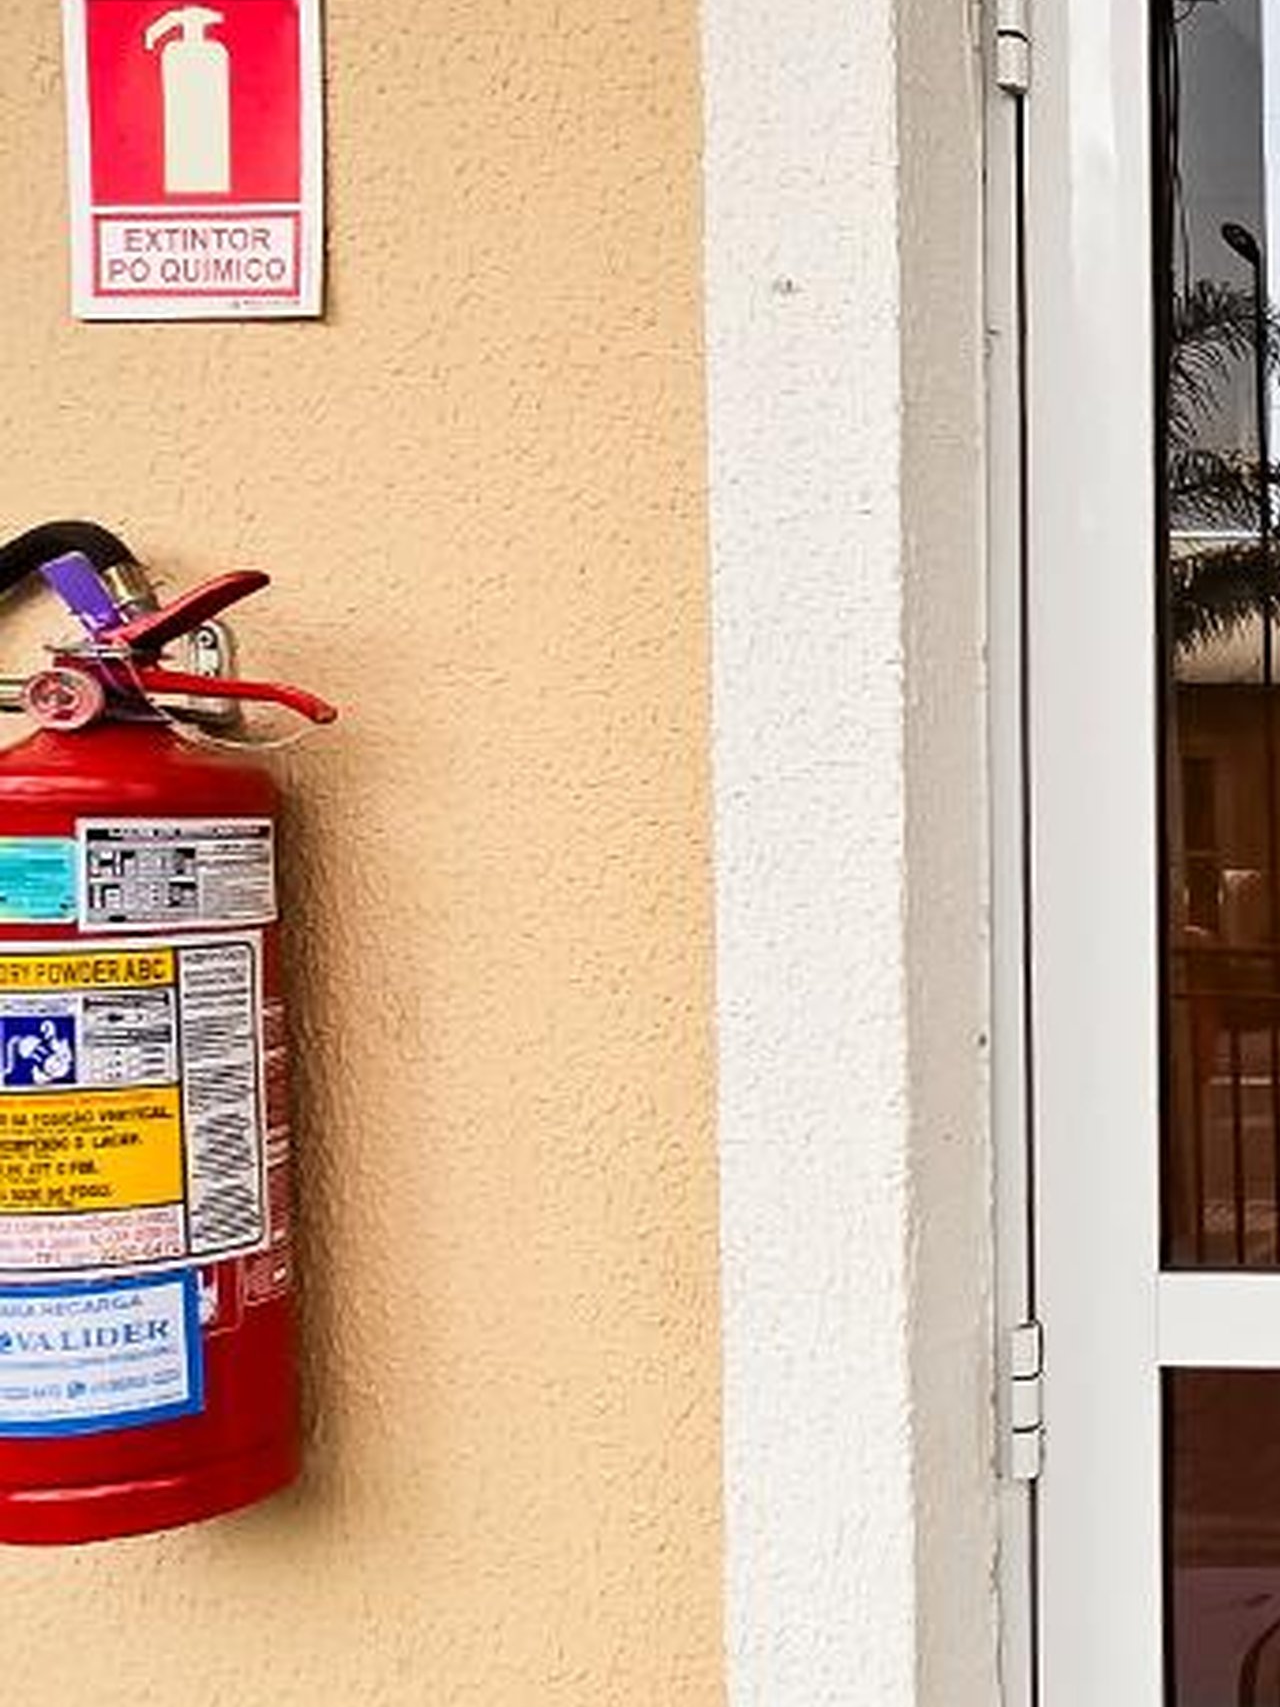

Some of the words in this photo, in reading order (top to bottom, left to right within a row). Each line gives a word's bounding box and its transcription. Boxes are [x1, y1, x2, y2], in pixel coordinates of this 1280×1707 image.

[124, 228, 271, 251] EXTINTOR
[35, 959, 120, 985] POWDER
[123, 957, 166, 983] ABC
